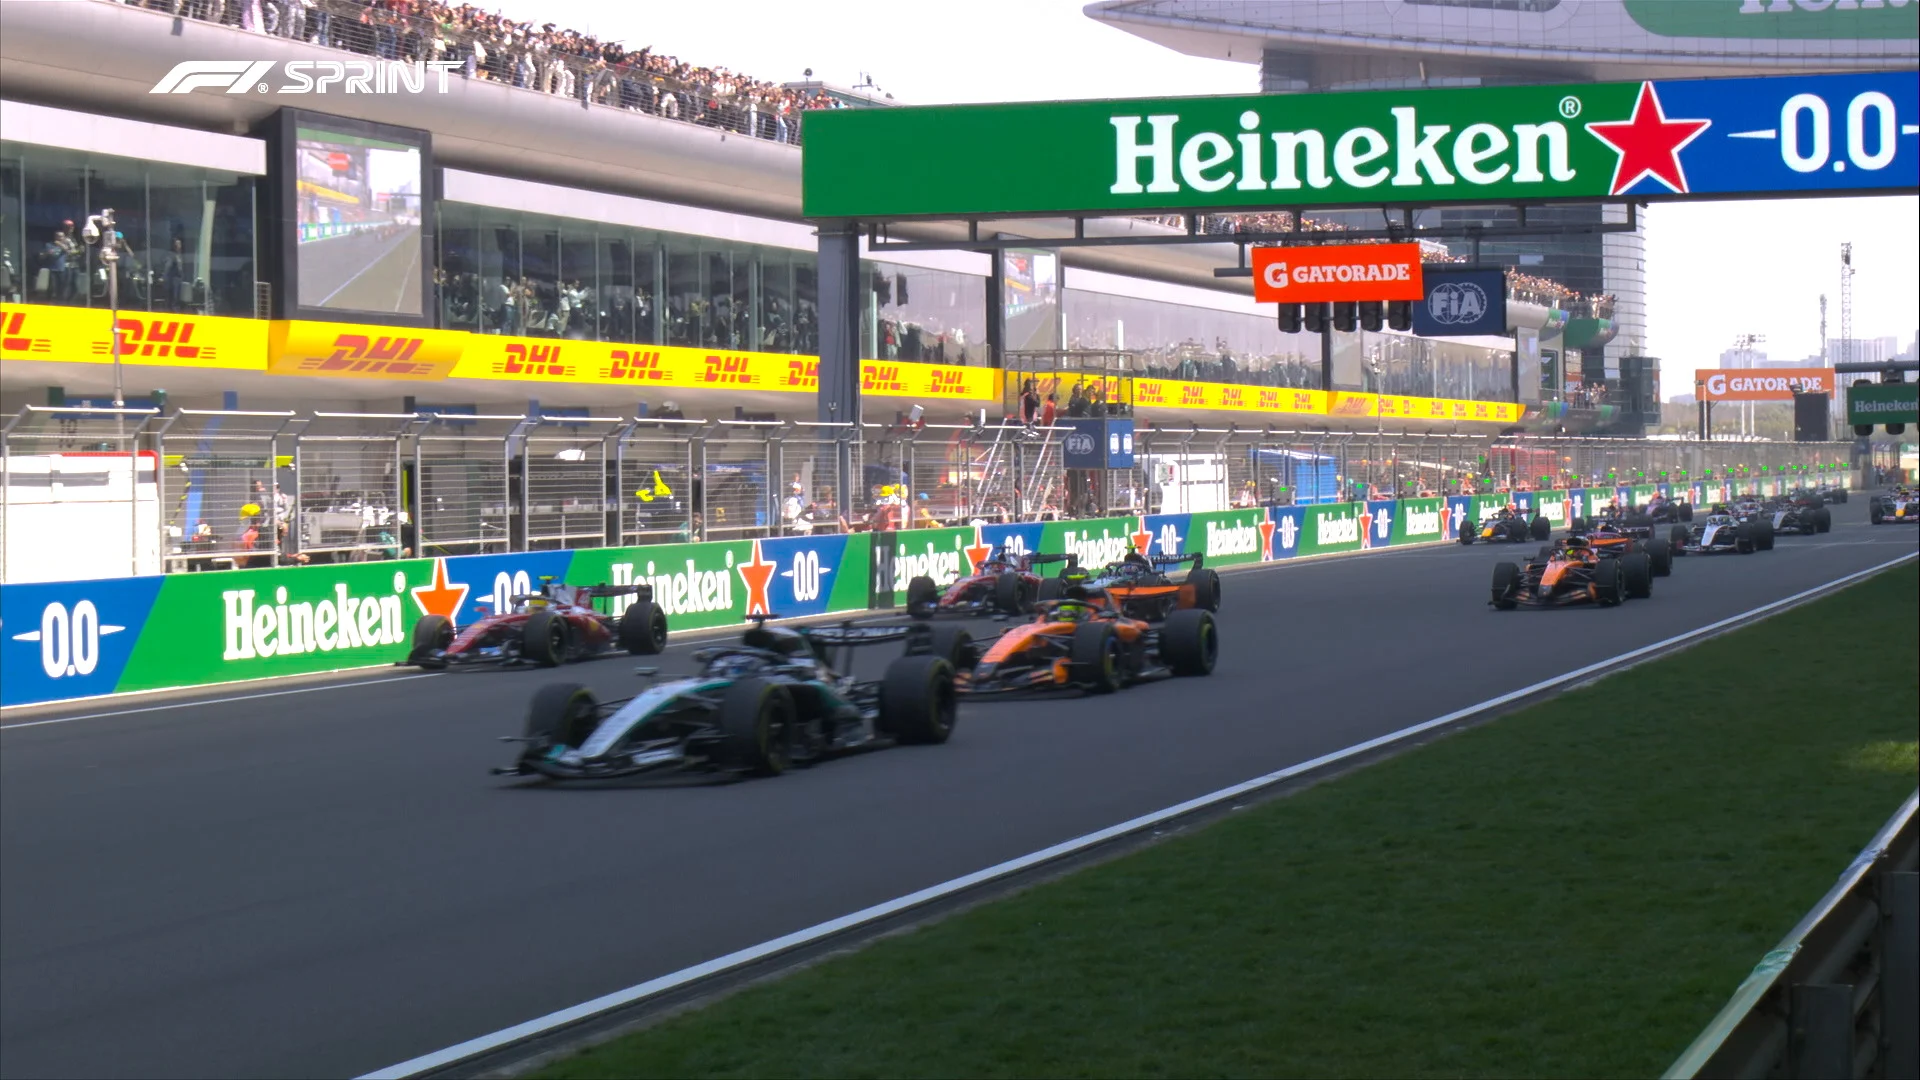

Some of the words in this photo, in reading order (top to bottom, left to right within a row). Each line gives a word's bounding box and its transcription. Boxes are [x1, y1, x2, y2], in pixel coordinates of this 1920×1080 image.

[1780, 91, 1896, 173] 0.0
[1292, 263, 1410, 283] GATORADE
[110, 319, 200, 359] DHL
[318, 334, 424, 374] DHL
[504, 344, 565, 376] DHL
[610, 350, 663, 381] DHL
[704, 355, 752, 384] DHL
[788, 361, 819, 386] DH
[862, 365, 901, 391] DHL
[930, 370, 965, 394] DHL
[1138, 383, 1163, 403] DHL
[1182, 386, 1205, 405] DHL
[1221, 388, 1244, 407] DHL
[1259, 390, 1279, 408] DHL
[1854, 400, 1918, 413] Heineken
[42, 599, 98, 679] 0.0
